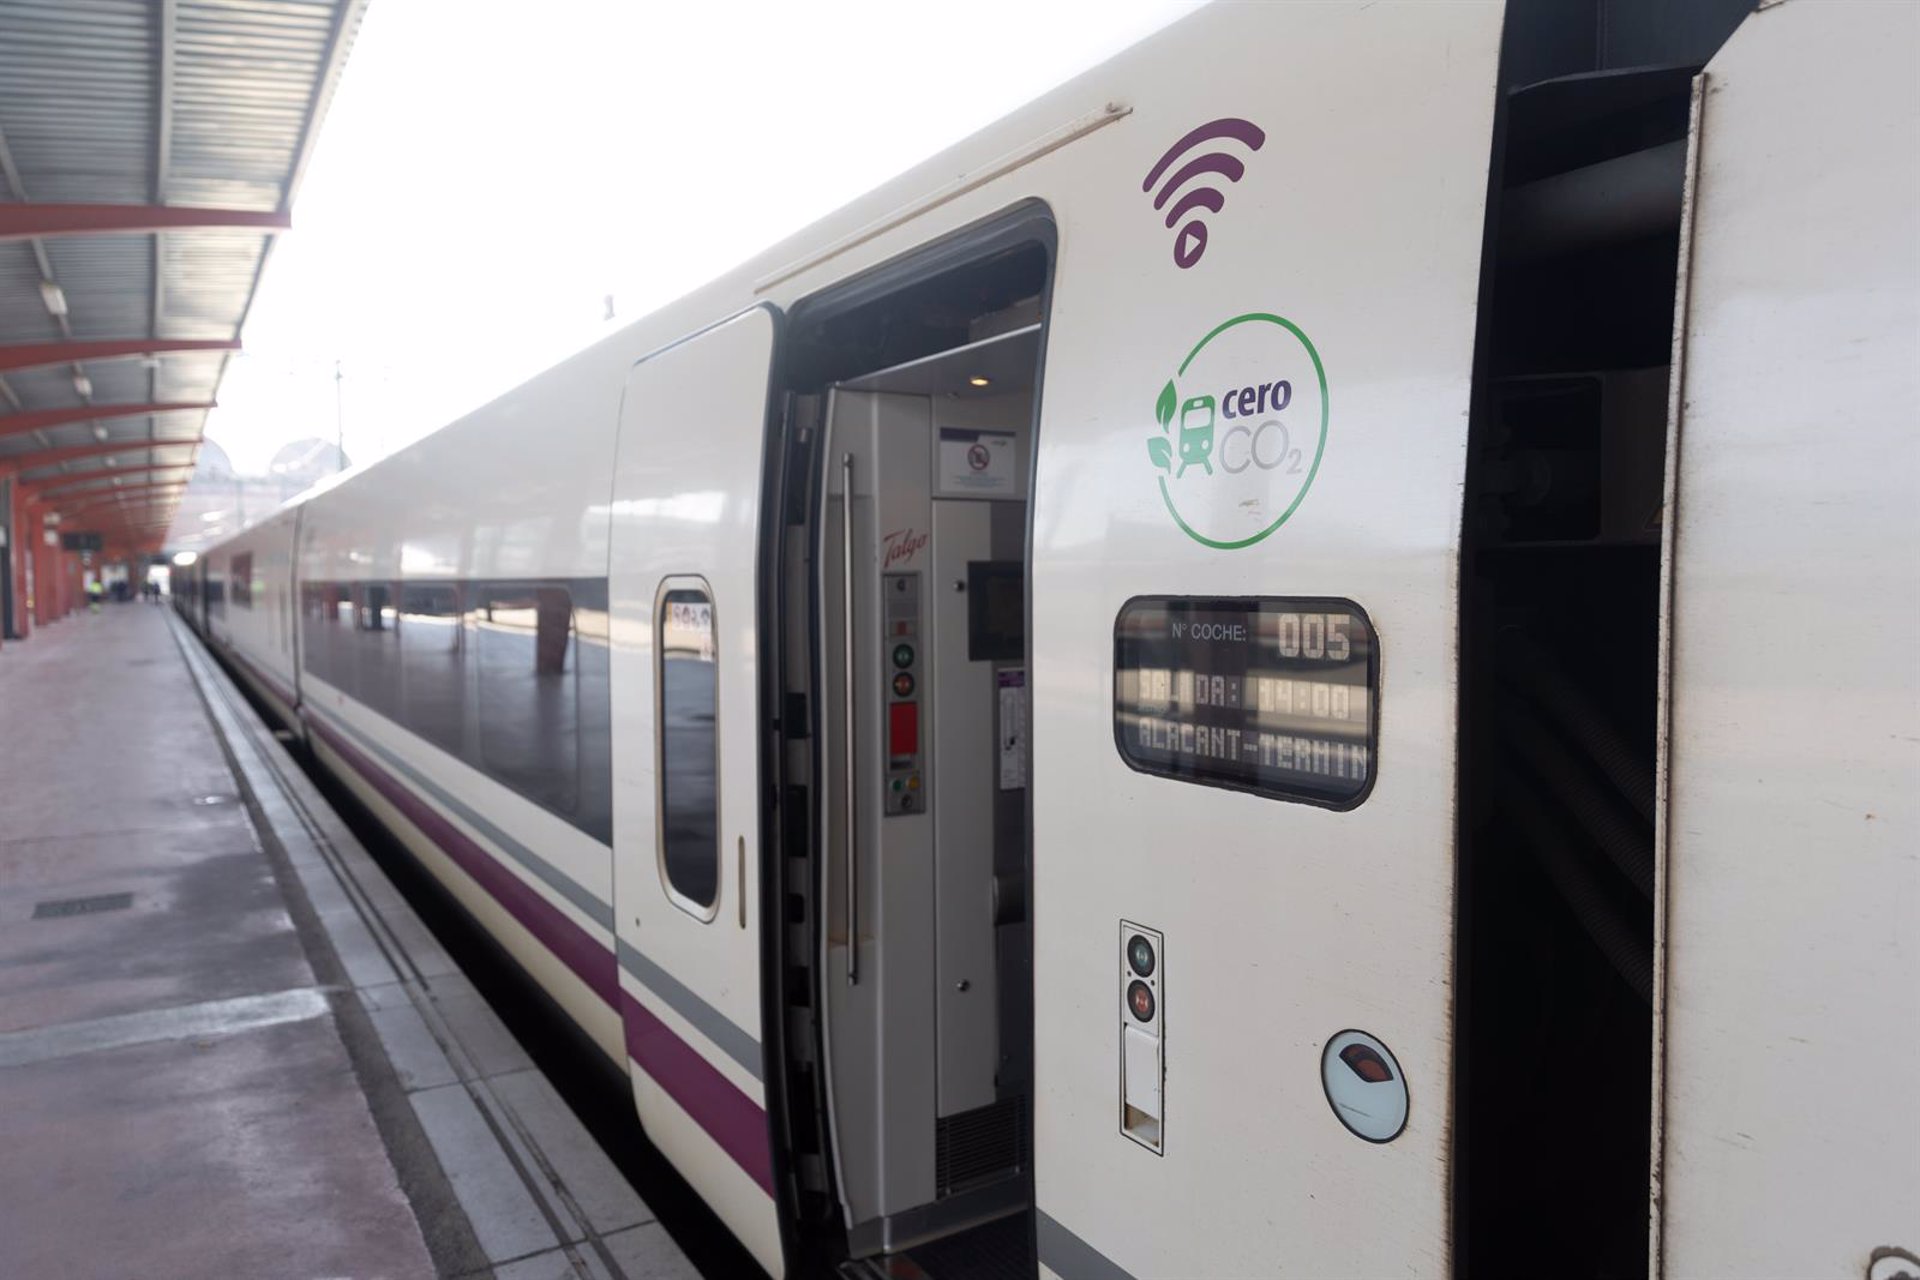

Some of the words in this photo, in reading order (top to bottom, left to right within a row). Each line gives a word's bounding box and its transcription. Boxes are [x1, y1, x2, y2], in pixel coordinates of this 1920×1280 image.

[1222, 380, 1292, 419] cero
[883, 528, 928, 569] Talgo
[1191, 624, 1247, 642] COCHE:
[1278, 613, 1350, 660] 005
[1258, 677, 1350, 720] 14:00
[1138, 717, 1367, 779] ALACANT-TERMIN
